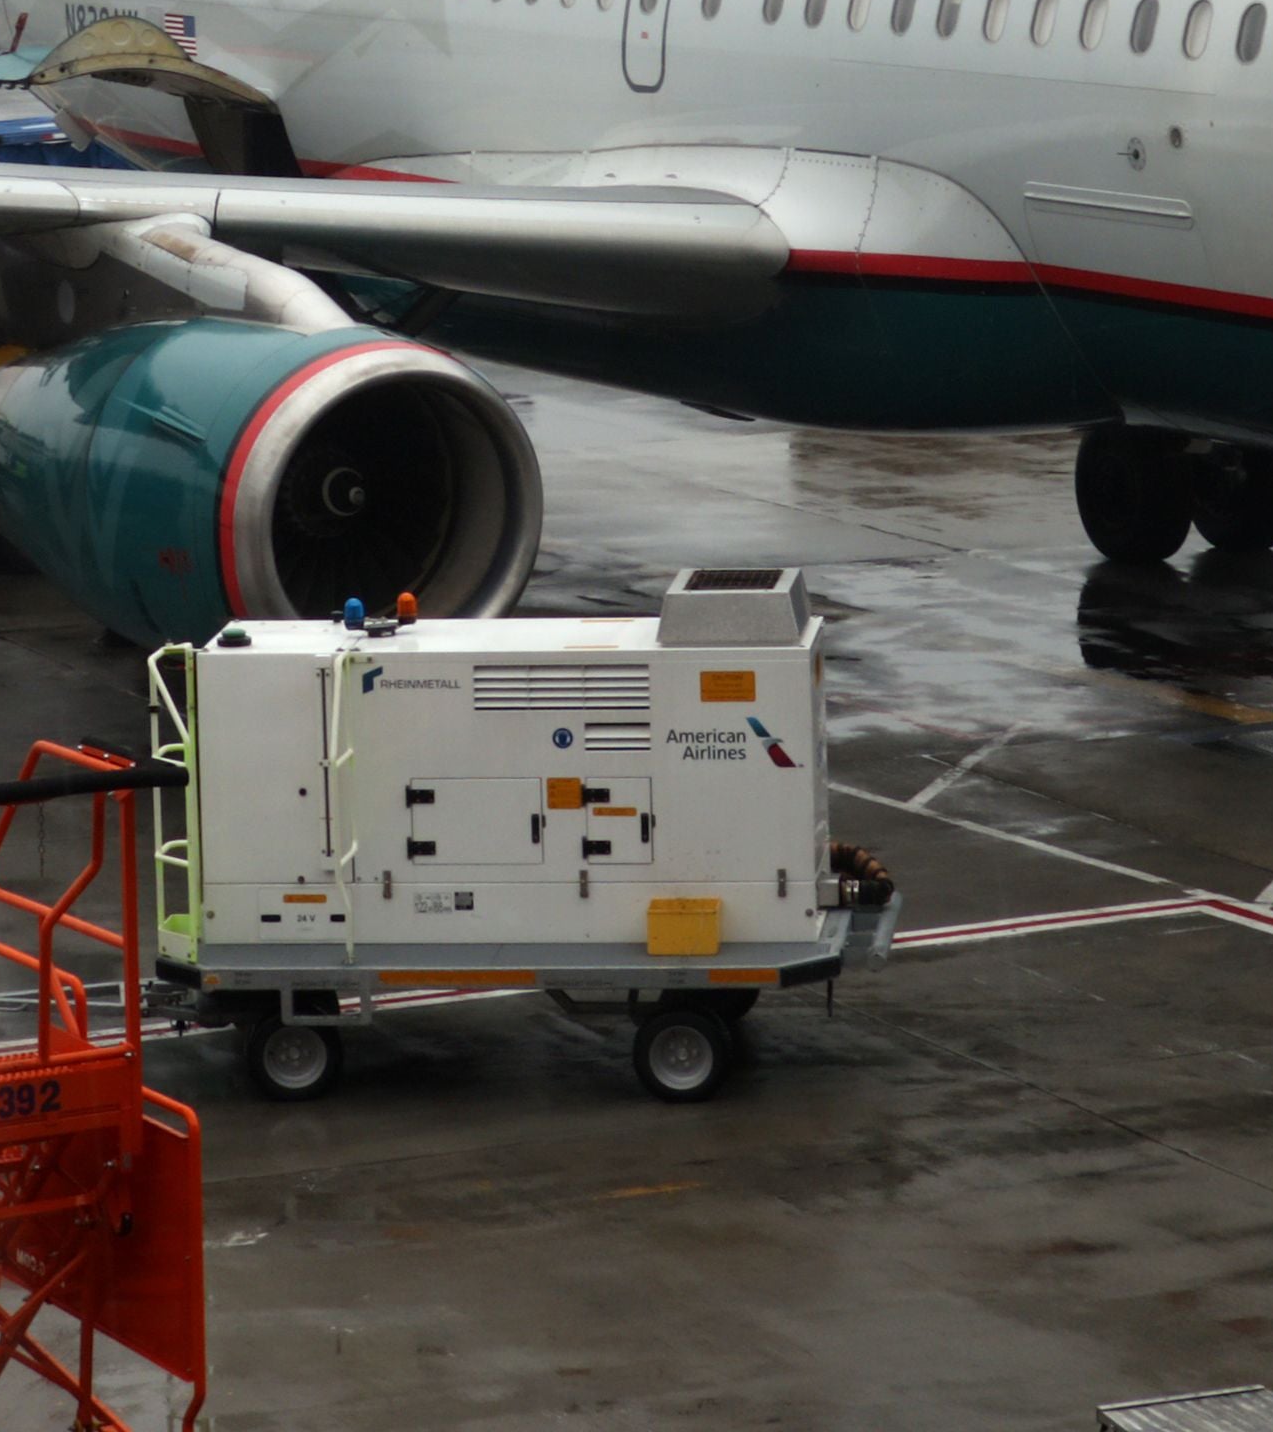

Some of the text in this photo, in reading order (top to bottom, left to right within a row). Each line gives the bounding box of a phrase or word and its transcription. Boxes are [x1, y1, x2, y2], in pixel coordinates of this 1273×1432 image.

[379, 679, 461, 689] RHEINMETALL
[666, 728, 747, 743] American
[682, 746, 747, 760] Airlines
